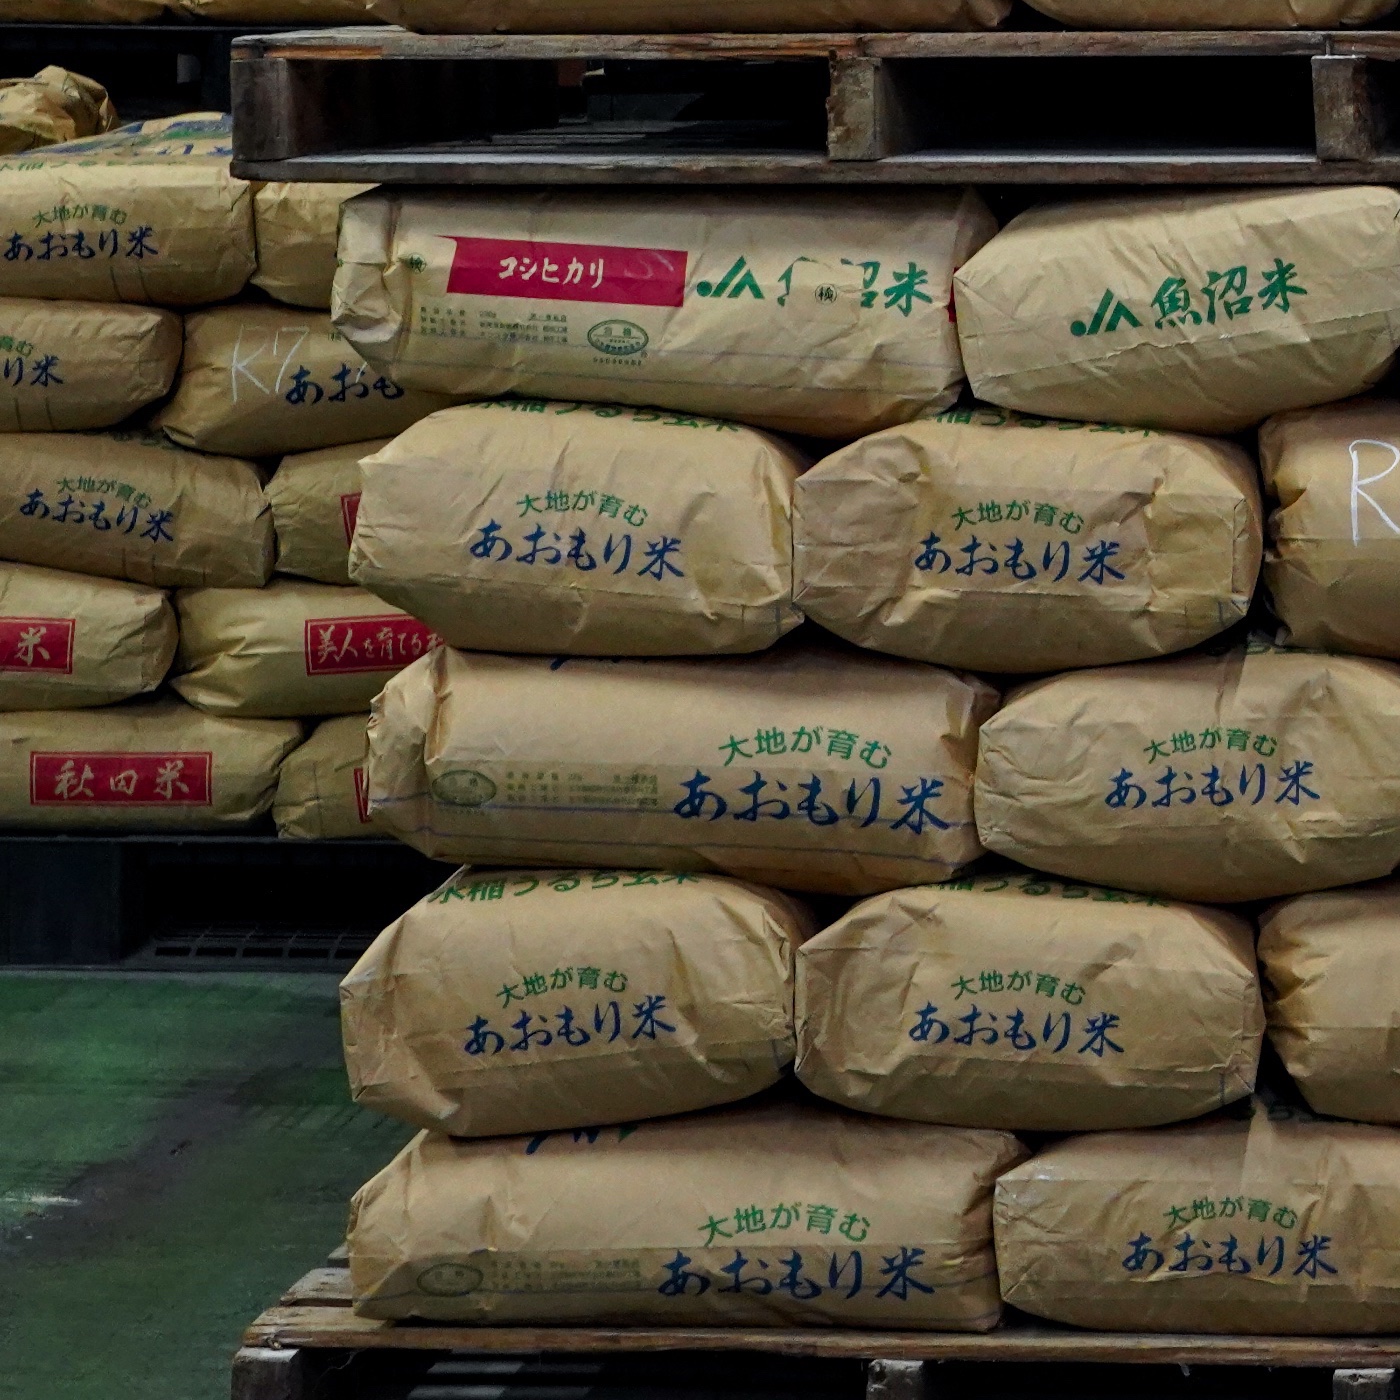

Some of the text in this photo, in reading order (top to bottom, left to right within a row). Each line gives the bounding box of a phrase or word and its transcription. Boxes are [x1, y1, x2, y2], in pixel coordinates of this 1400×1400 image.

[3, 227, 158, 262] あおもり米
[500, 257, 605, 288] コシヒカリ
[1150, 258, 1308, 330] 魚沼米
[2, 355, 64, 387] り米
[20, 488, 175, 544] あおもり米
[517, 491, 649, 527] 大地が育む
[953, 499, 1085, 534] 大地が育む
[469, 519, 687, 580] あおもり米
[914, 533, 1127, 584] あおもり米
[13, 625, 49, 666] 米
[718, 727, 892, 768] 大地が育む
[1143, 727, 1278, 765] 大地が育む
[54, 760, 190, 800] 秋田米
[1105, 762, 1320, 808] あおもり米
[672, 772, 954, 836] あおもり米
[496, 966, 629, 1007] 大地が育む
[951, 971, 1086, 1005] 大地が育む
[464, 995, 677, 1057] あおもり米
[908, 1001, 1125, 1058] あおもり米
[697, 1202, 870, 1244] 大地が育む
[1163, 1195, 1298, 1230] 大地が育む
[657, 1247, 936, 1302] あおもり米
[1122, 1232, 1338, 1277] あおもり米
